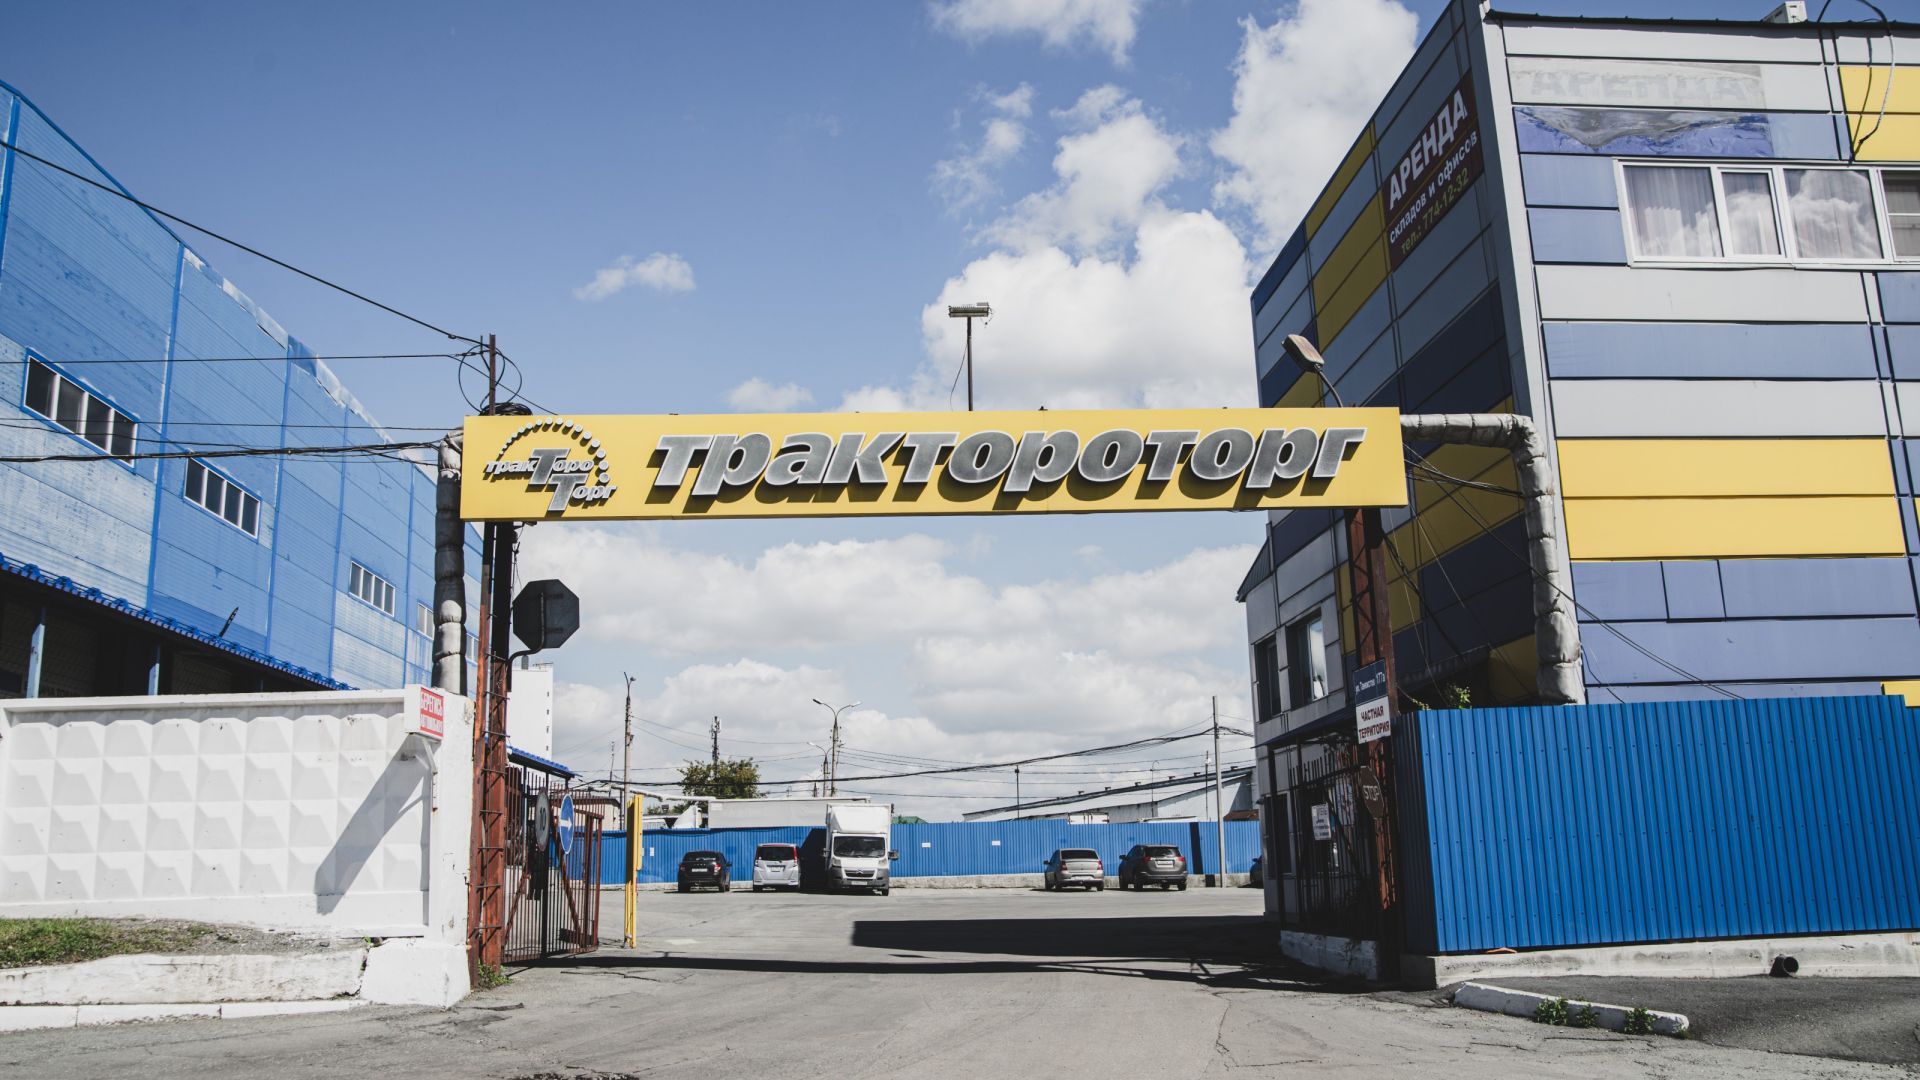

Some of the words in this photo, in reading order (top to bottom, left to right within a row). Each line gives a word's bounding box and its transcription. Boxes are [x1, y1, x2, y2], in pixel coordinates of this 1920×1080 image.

[1389, 89, 1468, 210] АРЕНДА
[1389, 193, 1427, 243] складов
[1428, 184, 1436, 199] и
[1437, 130, 1478, 187] офисов
[1422, 167, 1470, 230] 774-12-32
[1360, 705, 1385, 721] ЧАСТНАЯ
[1358, 720, 1390, 739] ТЕРРИТОРИЯ
[1362, 785, 1380, 801] STOP
[539, 806, 547, 831] 10
